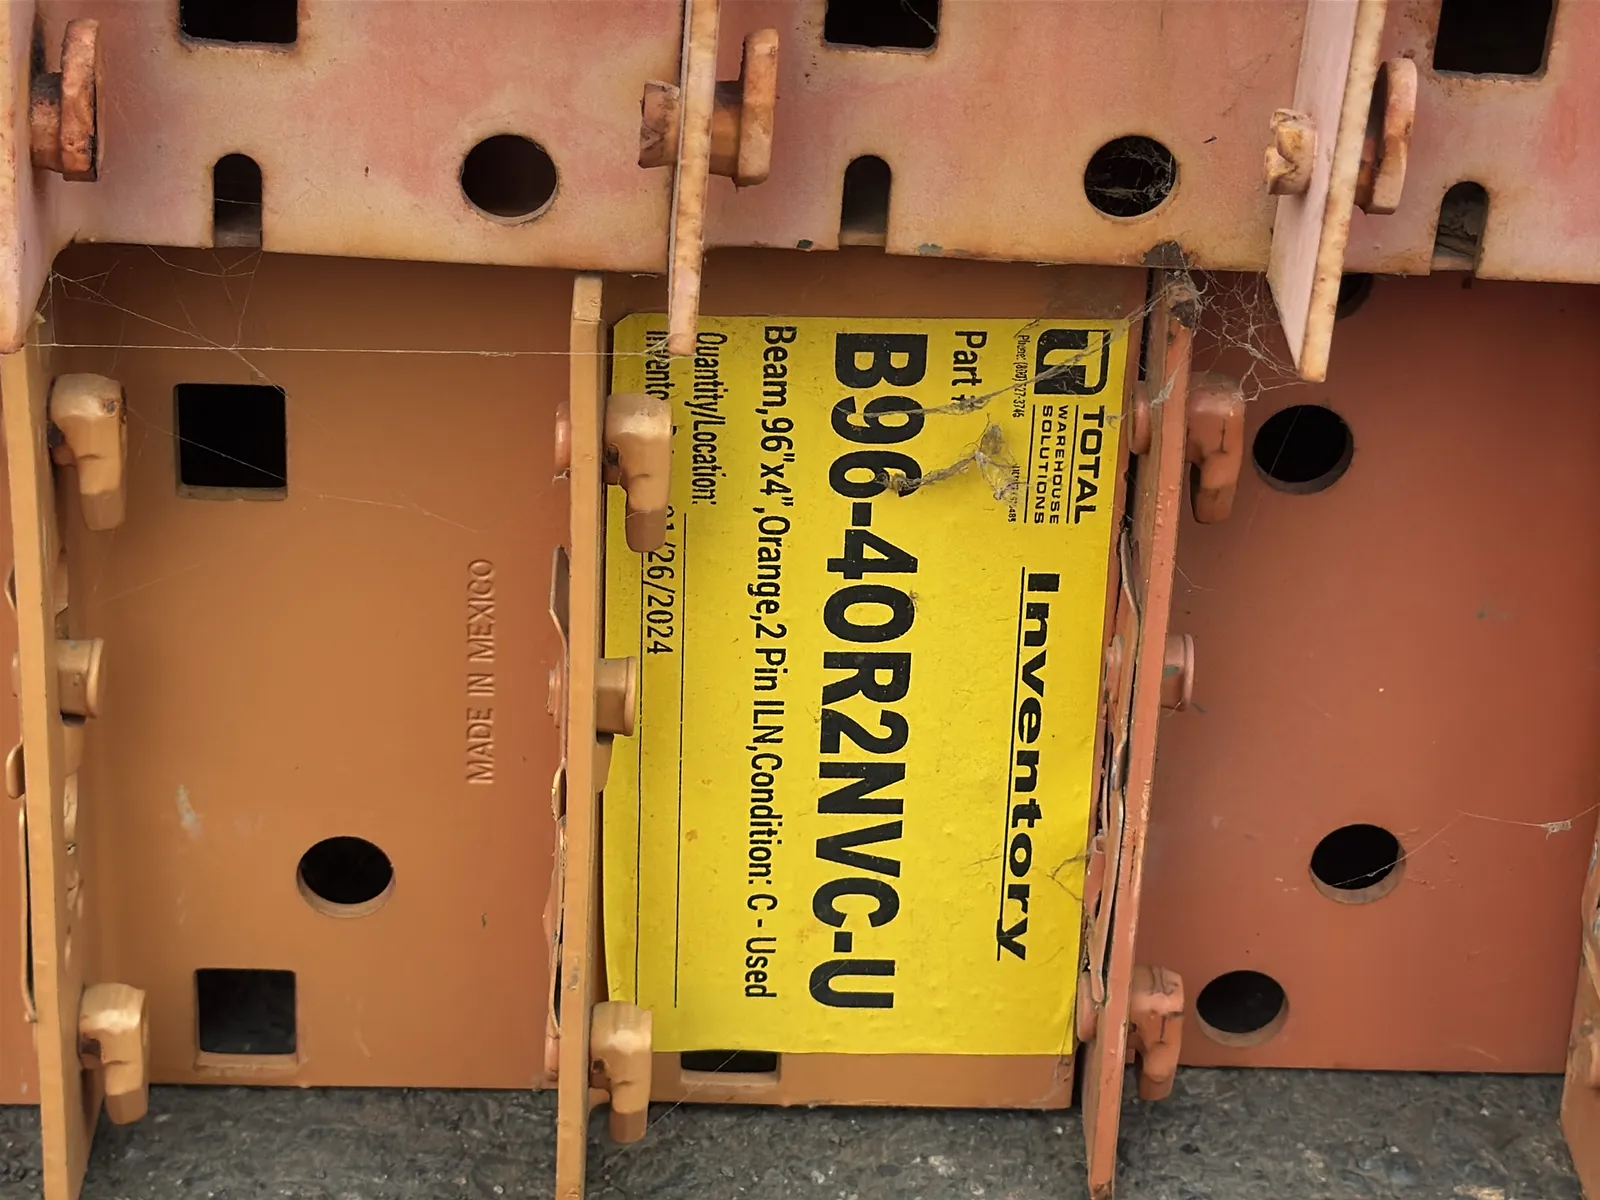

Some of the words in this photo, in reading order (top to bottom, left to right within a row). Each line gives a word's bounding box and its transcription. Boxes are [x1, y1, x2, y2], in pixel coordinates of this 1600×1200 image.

[951, 331, 987, 387] Part
[683, 333, 727, 505] Quantity/Location:
[1032, 405, 1052, 525] SOLUTIONS
[1048, 405, 1068, 525] WAREHOUSE
[1073, 405, 1104, 525] TOTAL
[466, 557, 496, 662] MEXICO
[466, 671, 495, 697] IN
[754, 648, 787, 691] Pin
[465, 705, 496, 784] MADE
[745, 700, 784, 885] ILN,Condition:
[996, 569, 1059, 962] Inventory
[747, 893, 776, 911] C
[744, 937, 777, 998] Used
